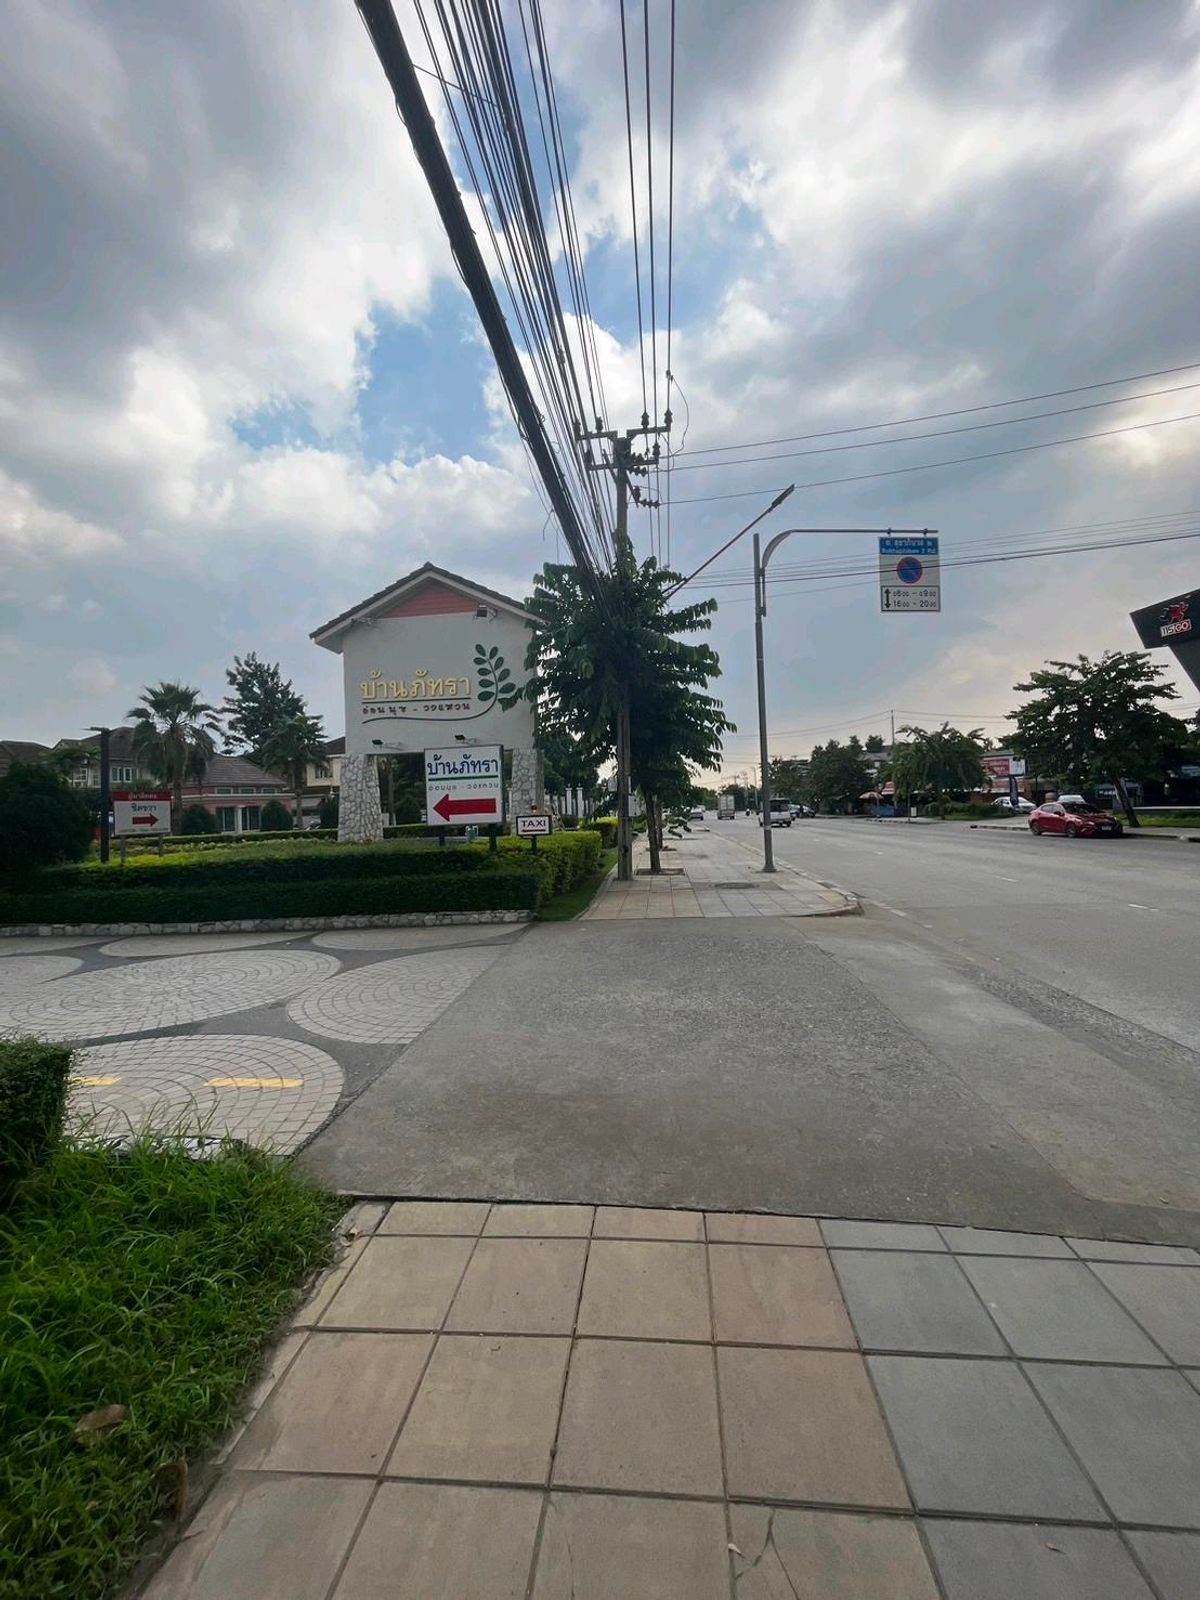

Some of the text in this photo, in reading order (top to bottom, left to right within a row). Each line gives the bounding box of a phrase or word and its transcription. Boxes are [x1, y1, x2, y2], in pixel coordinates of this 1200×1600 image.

[361, 669, 471, 699] บ้านภัทรา
[427, 754, 499, 776] บ้านภัทรา
[521, 819, 546, 829] TAXI
